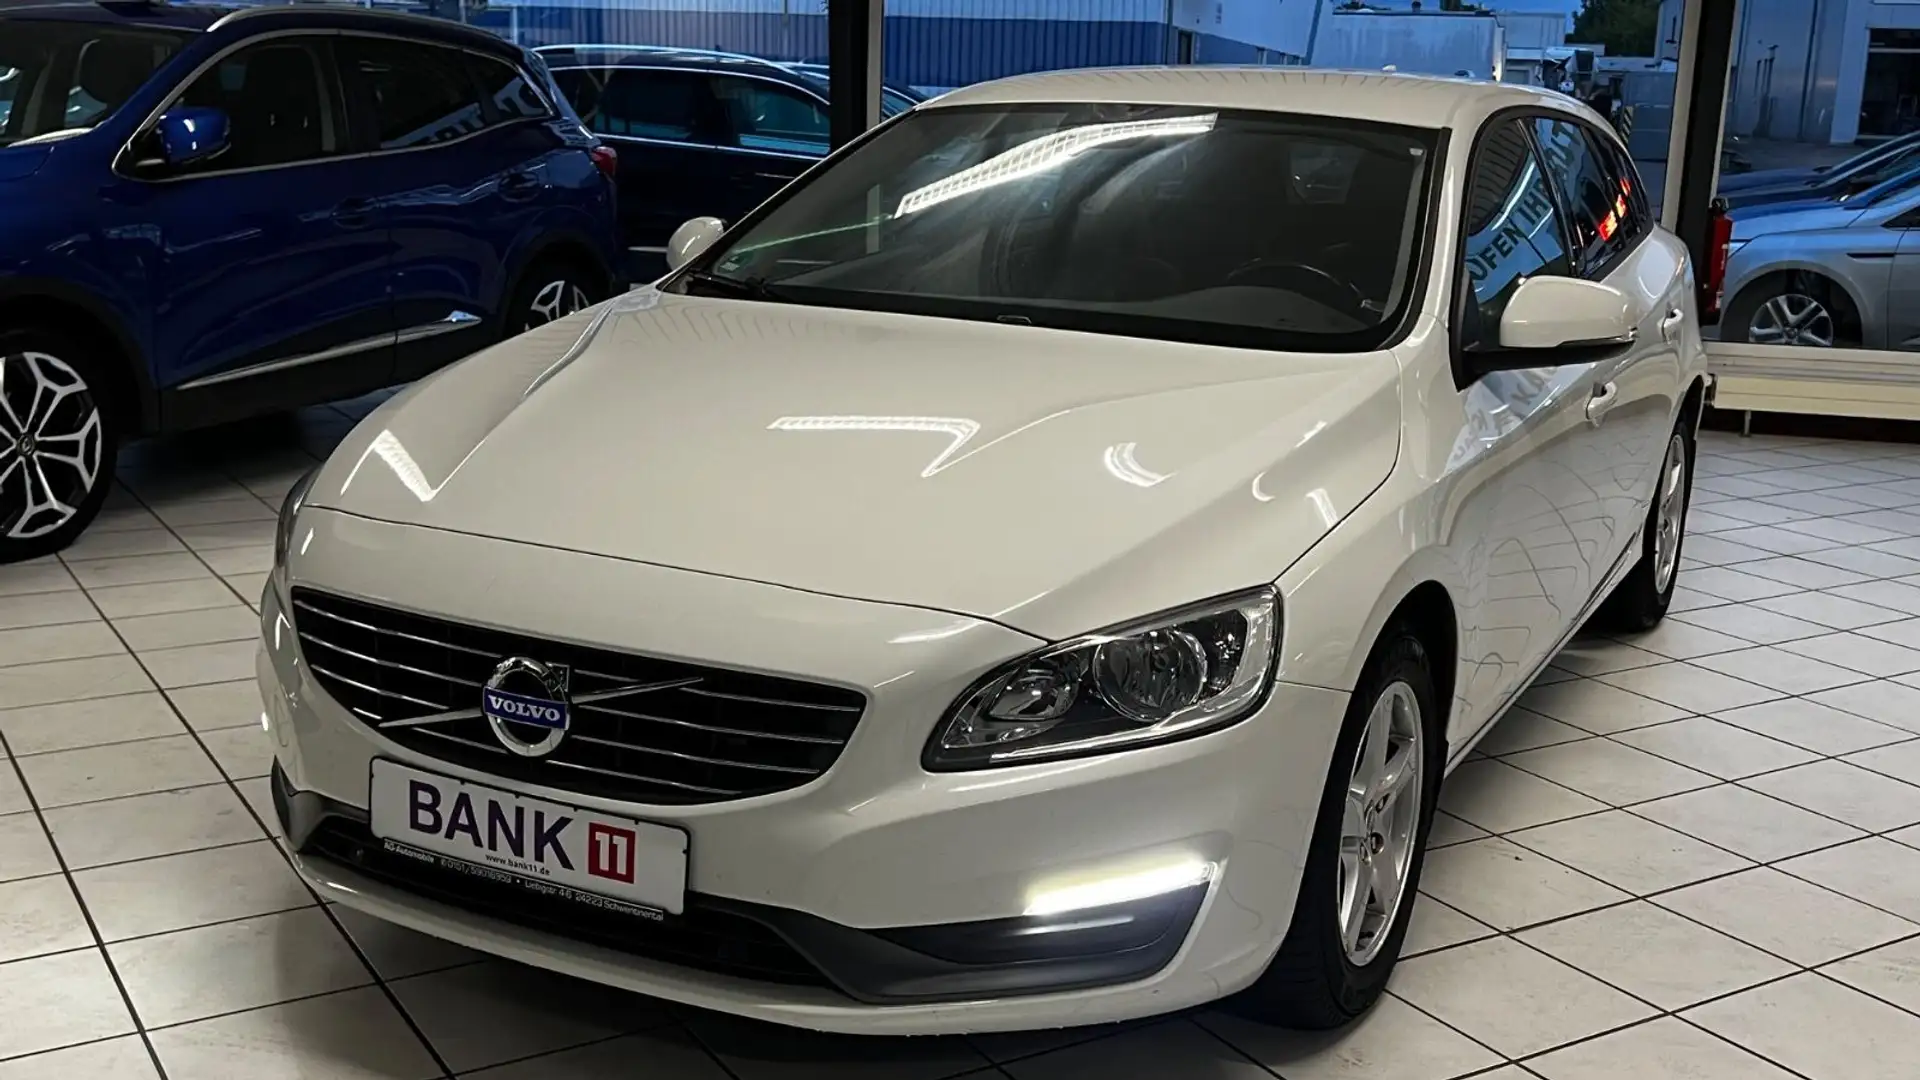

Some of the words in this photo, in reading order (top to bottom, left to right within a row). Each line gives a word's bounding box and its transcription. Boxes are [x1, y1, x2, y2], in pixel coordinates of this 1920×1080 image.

[487, 694, 561, 722] VOLVO
[408, 779, 575, 871] BANK
[593, 829, 630, 878] 11
[485, 854, 550, 875] www.bank11.de
